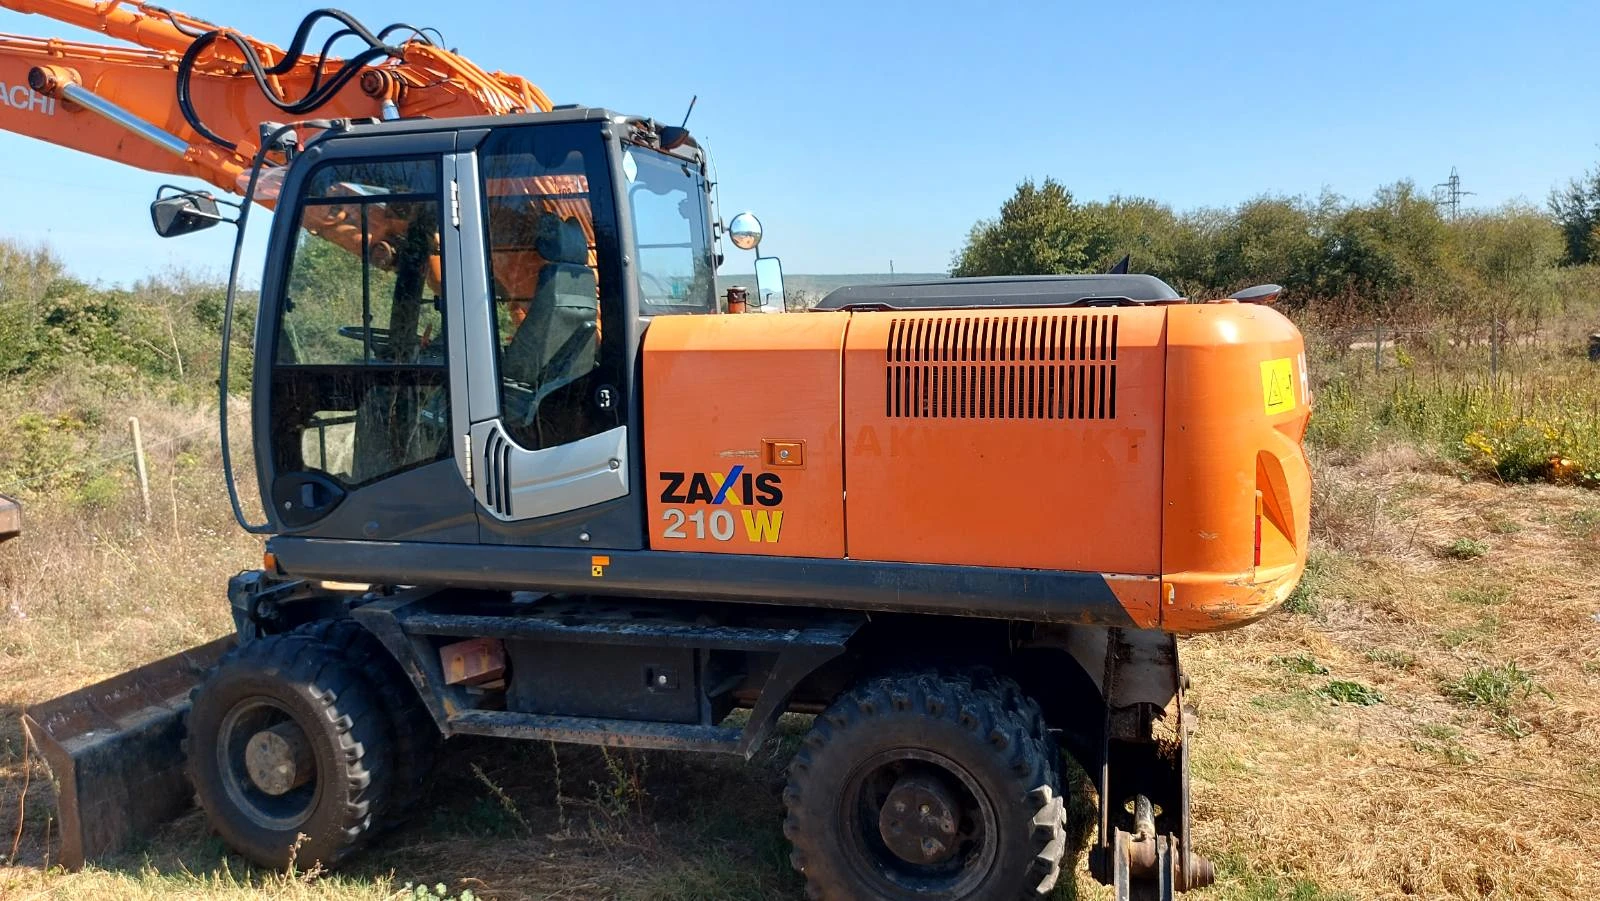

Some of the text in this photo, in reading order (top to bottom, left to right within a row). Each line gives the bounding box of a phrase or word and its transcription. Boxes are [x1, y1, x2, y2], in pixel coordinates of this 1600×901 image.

[659, 465, 783, 506] ZAXIS
[662, 508, 784, 543] 210 W
